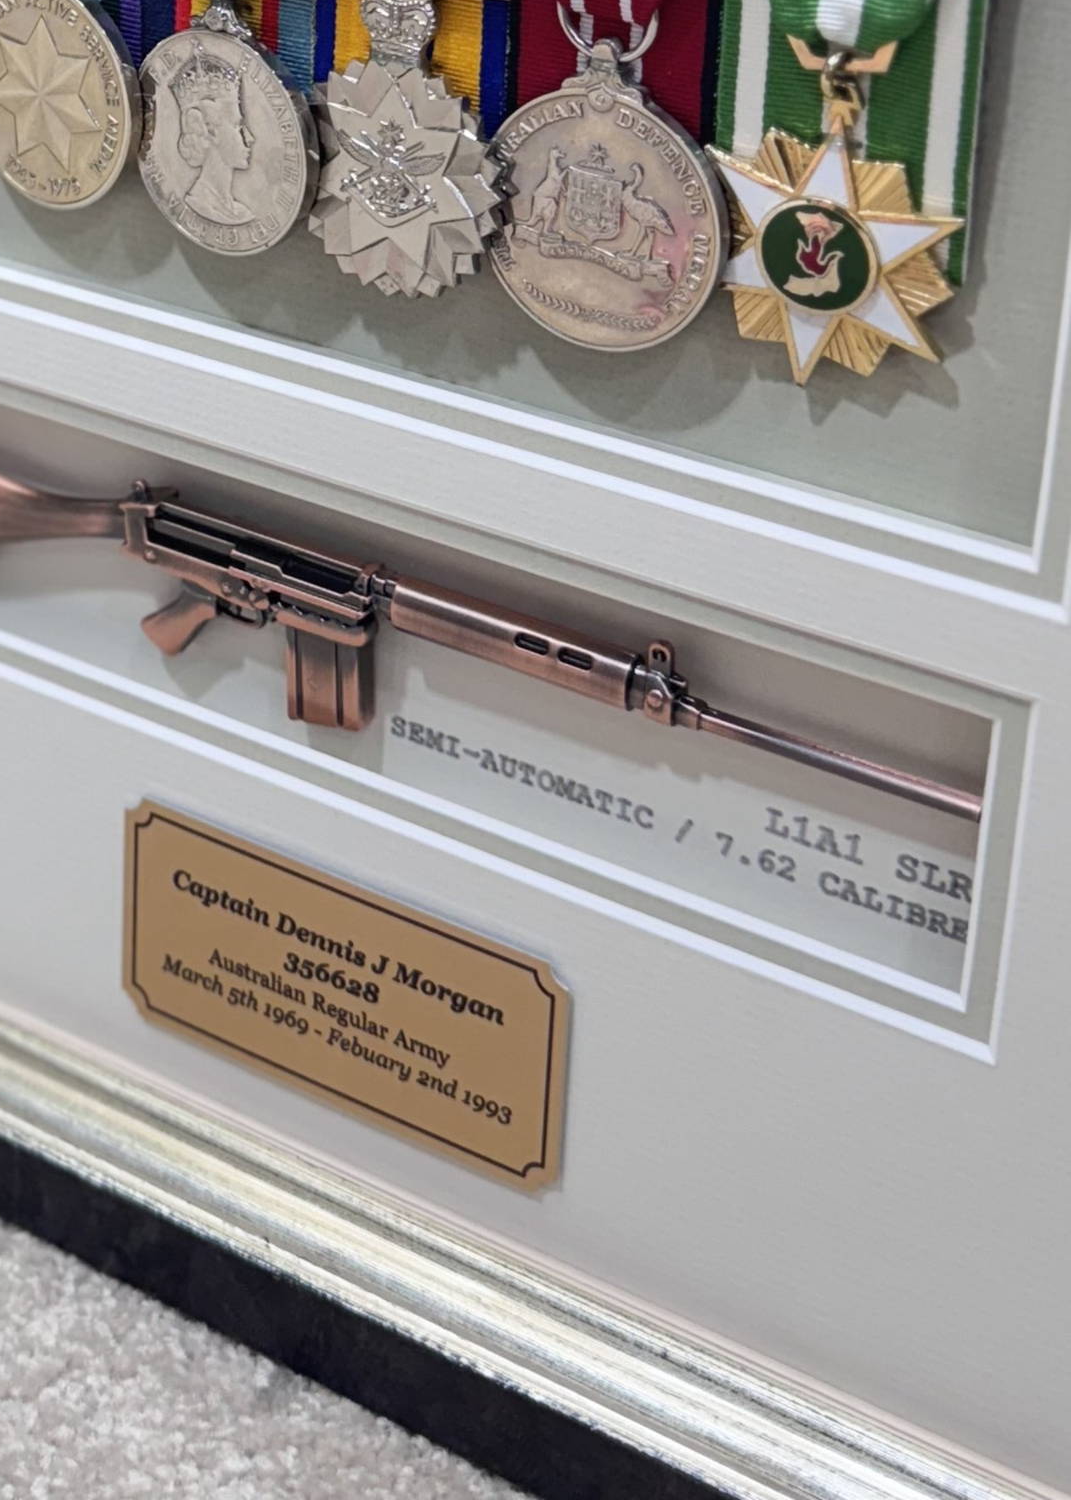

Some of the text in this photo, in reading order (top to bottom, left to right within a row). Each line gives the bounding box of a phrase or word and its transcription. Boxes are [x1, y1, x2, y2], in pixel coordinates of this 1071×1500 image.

[79, 26, 120, 107] SERVICE
[241, 53, 302, 185] ELIZABETH
[616, 107, 708, 216] DEFENCE
[390, 715, 969, 944] SEMI-AUTOMATIC / 7.62 CALIBRE
[765, 807, 973, 904] L1A1 SLR
[172, 869, 505, 1026] Captain Dennis J Morgan
[282, 952, 381, 1004] 356628
[162, 953, 224, 997] March
[226, 987, 259, 1012] 5th
[263, 1003, 309, 1036] 1969
[326, 1027, 412, 1083] Febuary
[415, 1070, 459, 1100] 2nd
[461, 1090, 513, 1125] 1993
[208, 948, 451, 1070] Australian Regular Army
